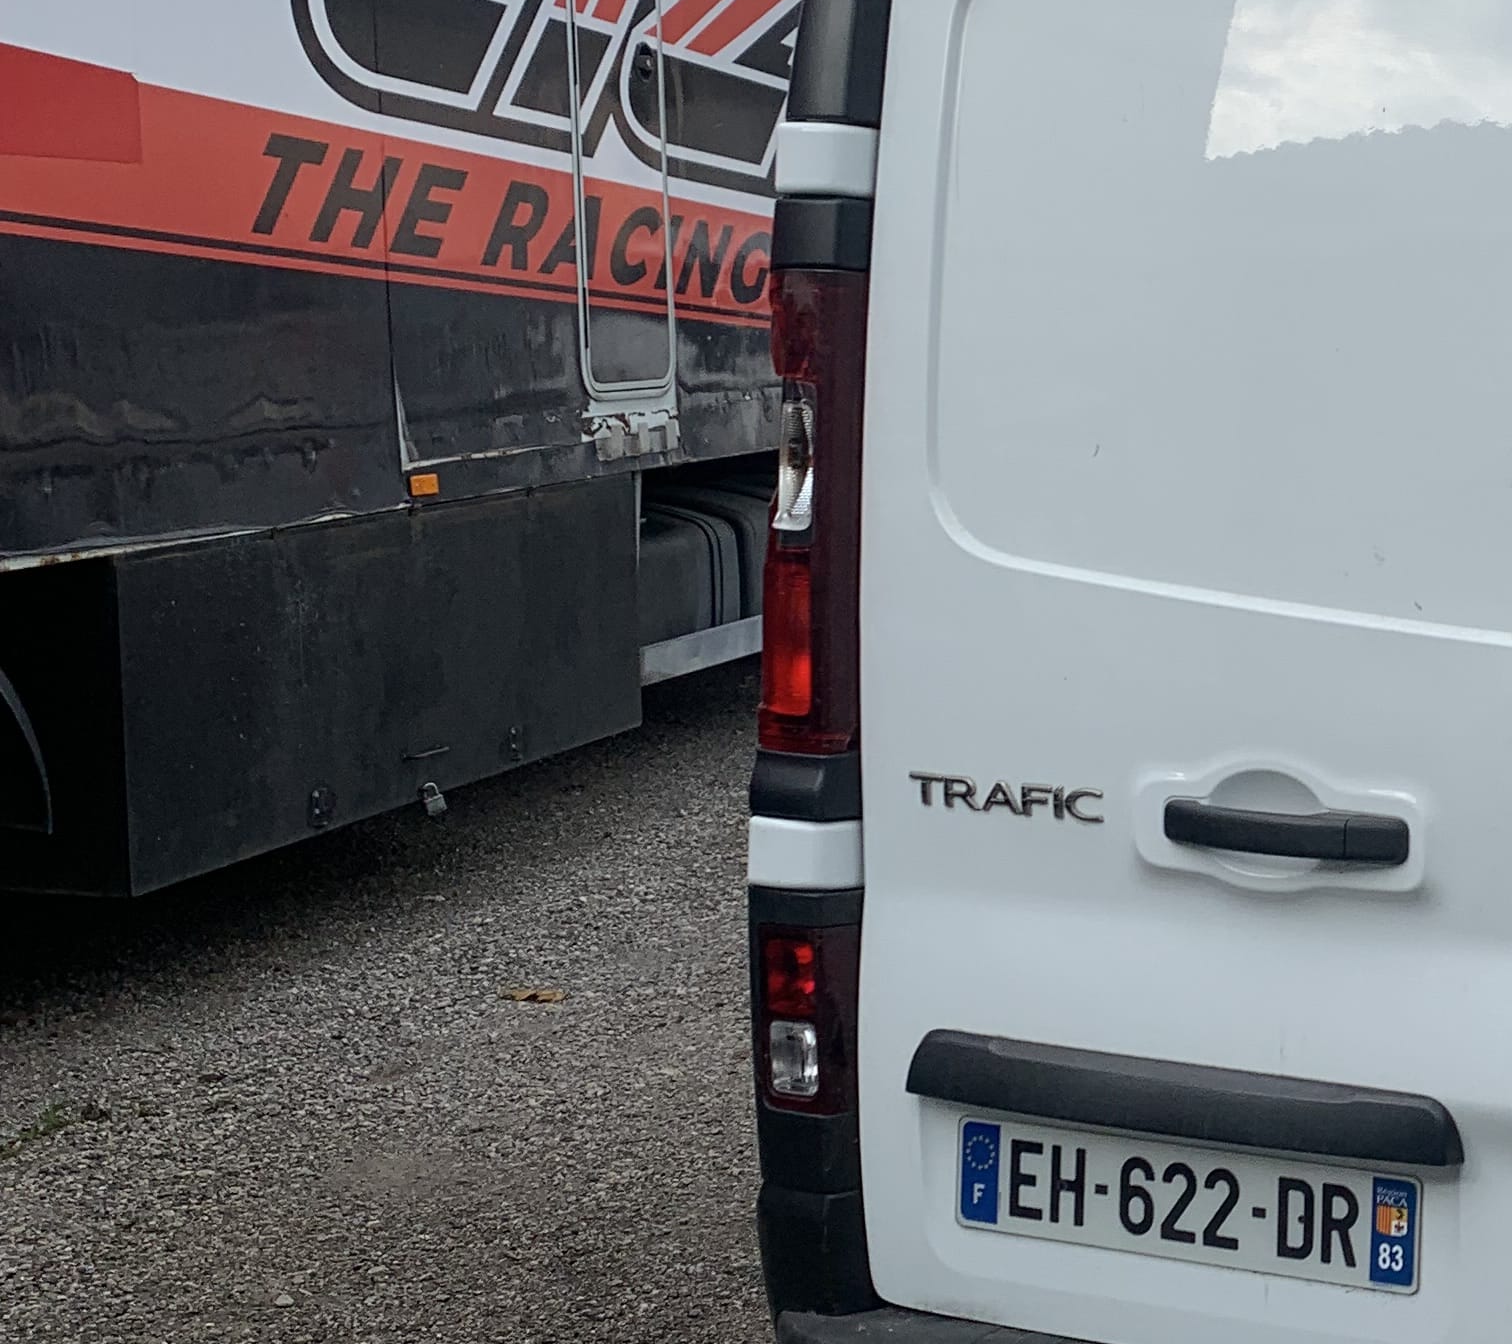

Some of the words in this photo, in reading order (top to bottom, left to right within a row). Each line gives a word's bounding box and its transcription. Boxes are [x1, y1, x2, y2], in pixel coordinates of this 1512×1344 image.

[251, 132, 469, 260] THE
[480, 179, 772, 306] RACING
[908, 770, 1105, 824] TRAFIC
[971, 1182, 986, 1205] F
[1008, 1138, 1360, 1269] EH-622-DR
[1376, 1194, 1408, 1208] PACA
[1378, 1242, 1404, 1272] 83
